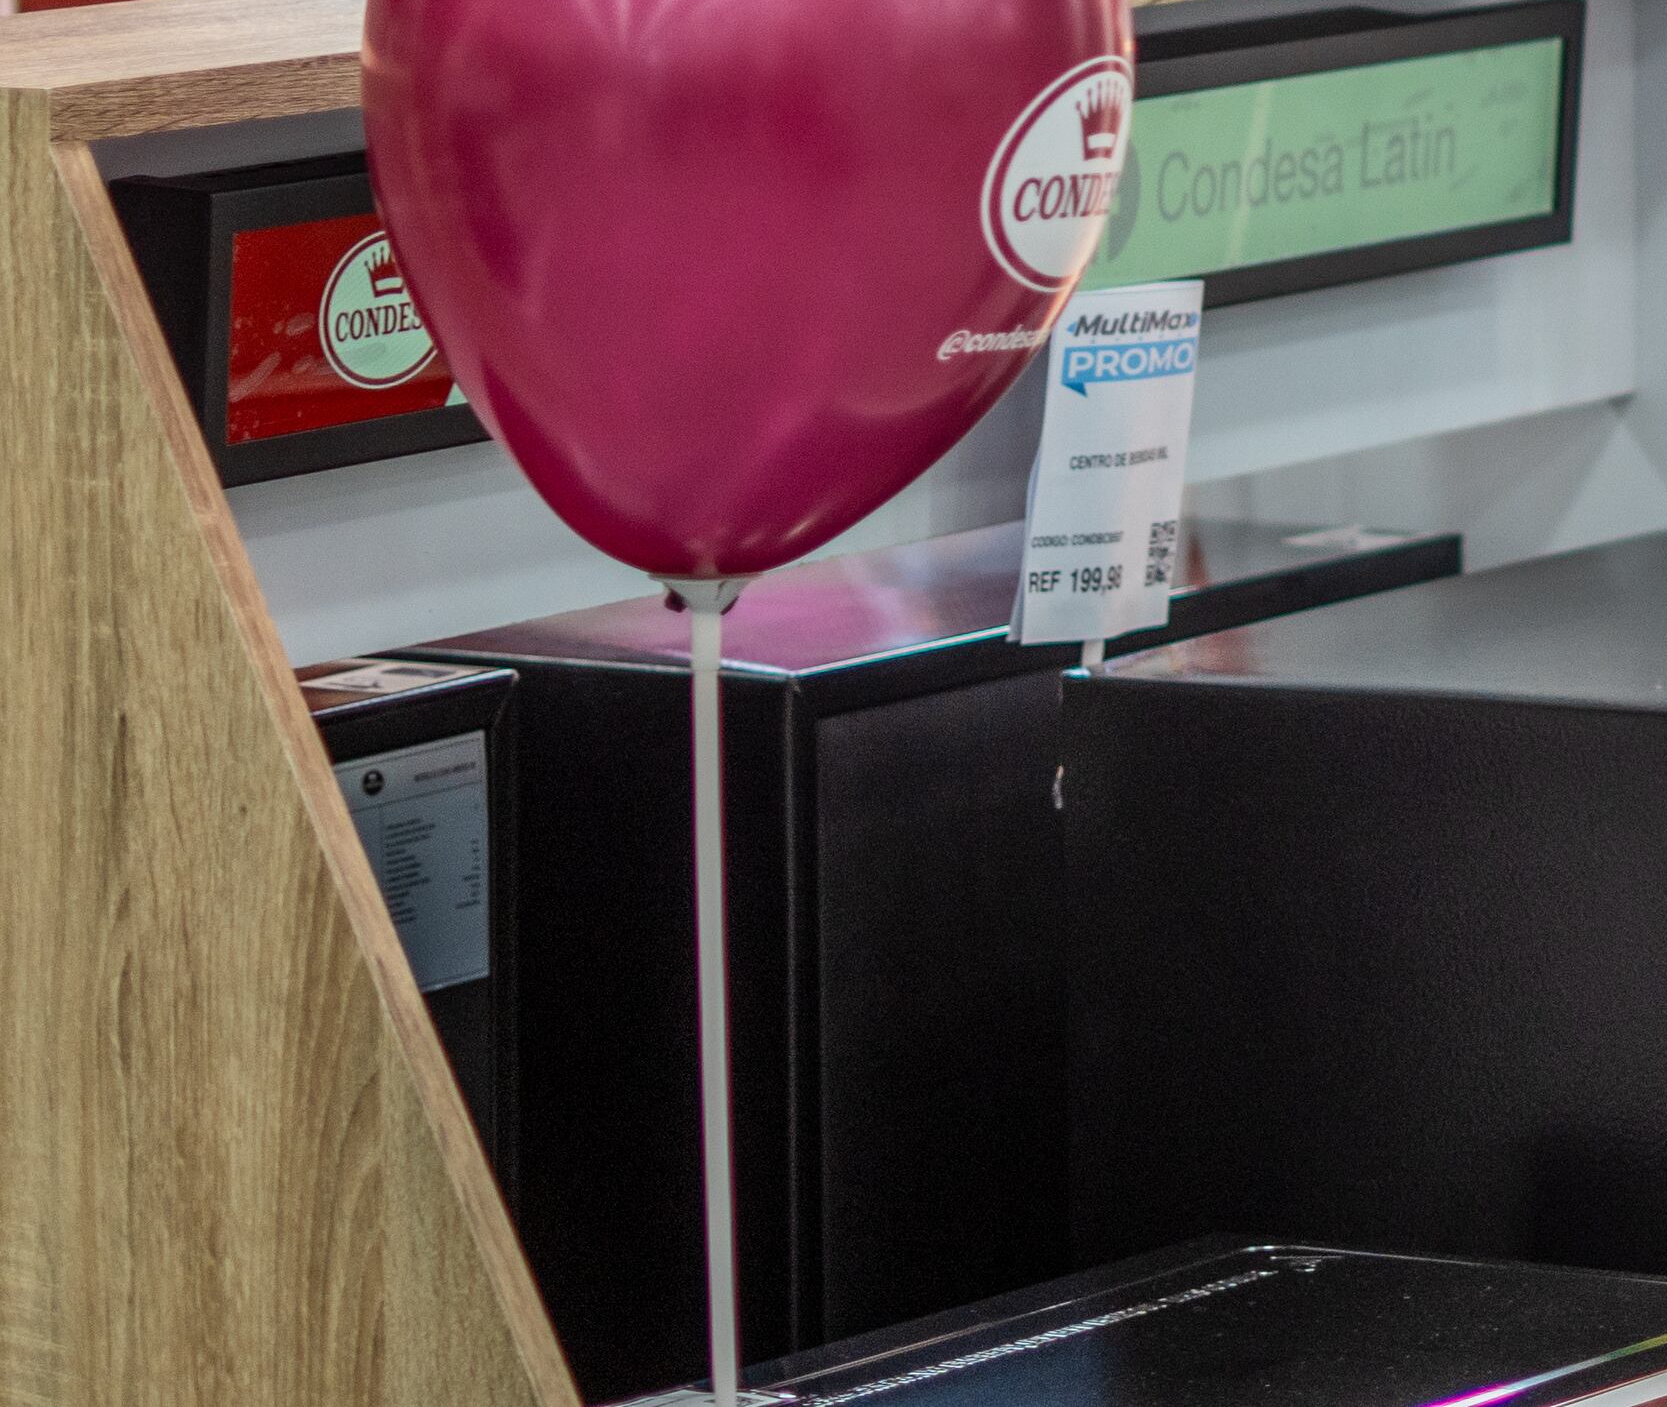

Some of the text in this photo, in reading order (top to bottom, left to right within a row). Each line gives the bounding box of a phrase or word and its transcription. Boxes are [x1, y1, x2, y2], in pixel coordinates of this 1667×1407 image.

[1157, 136, 1346, 222] Condesa
[1073, 309, 1194, 337] MultiMax
[1067, 342, 1195, 379] PROMO
[1029, 570, 1061, 592] REF
